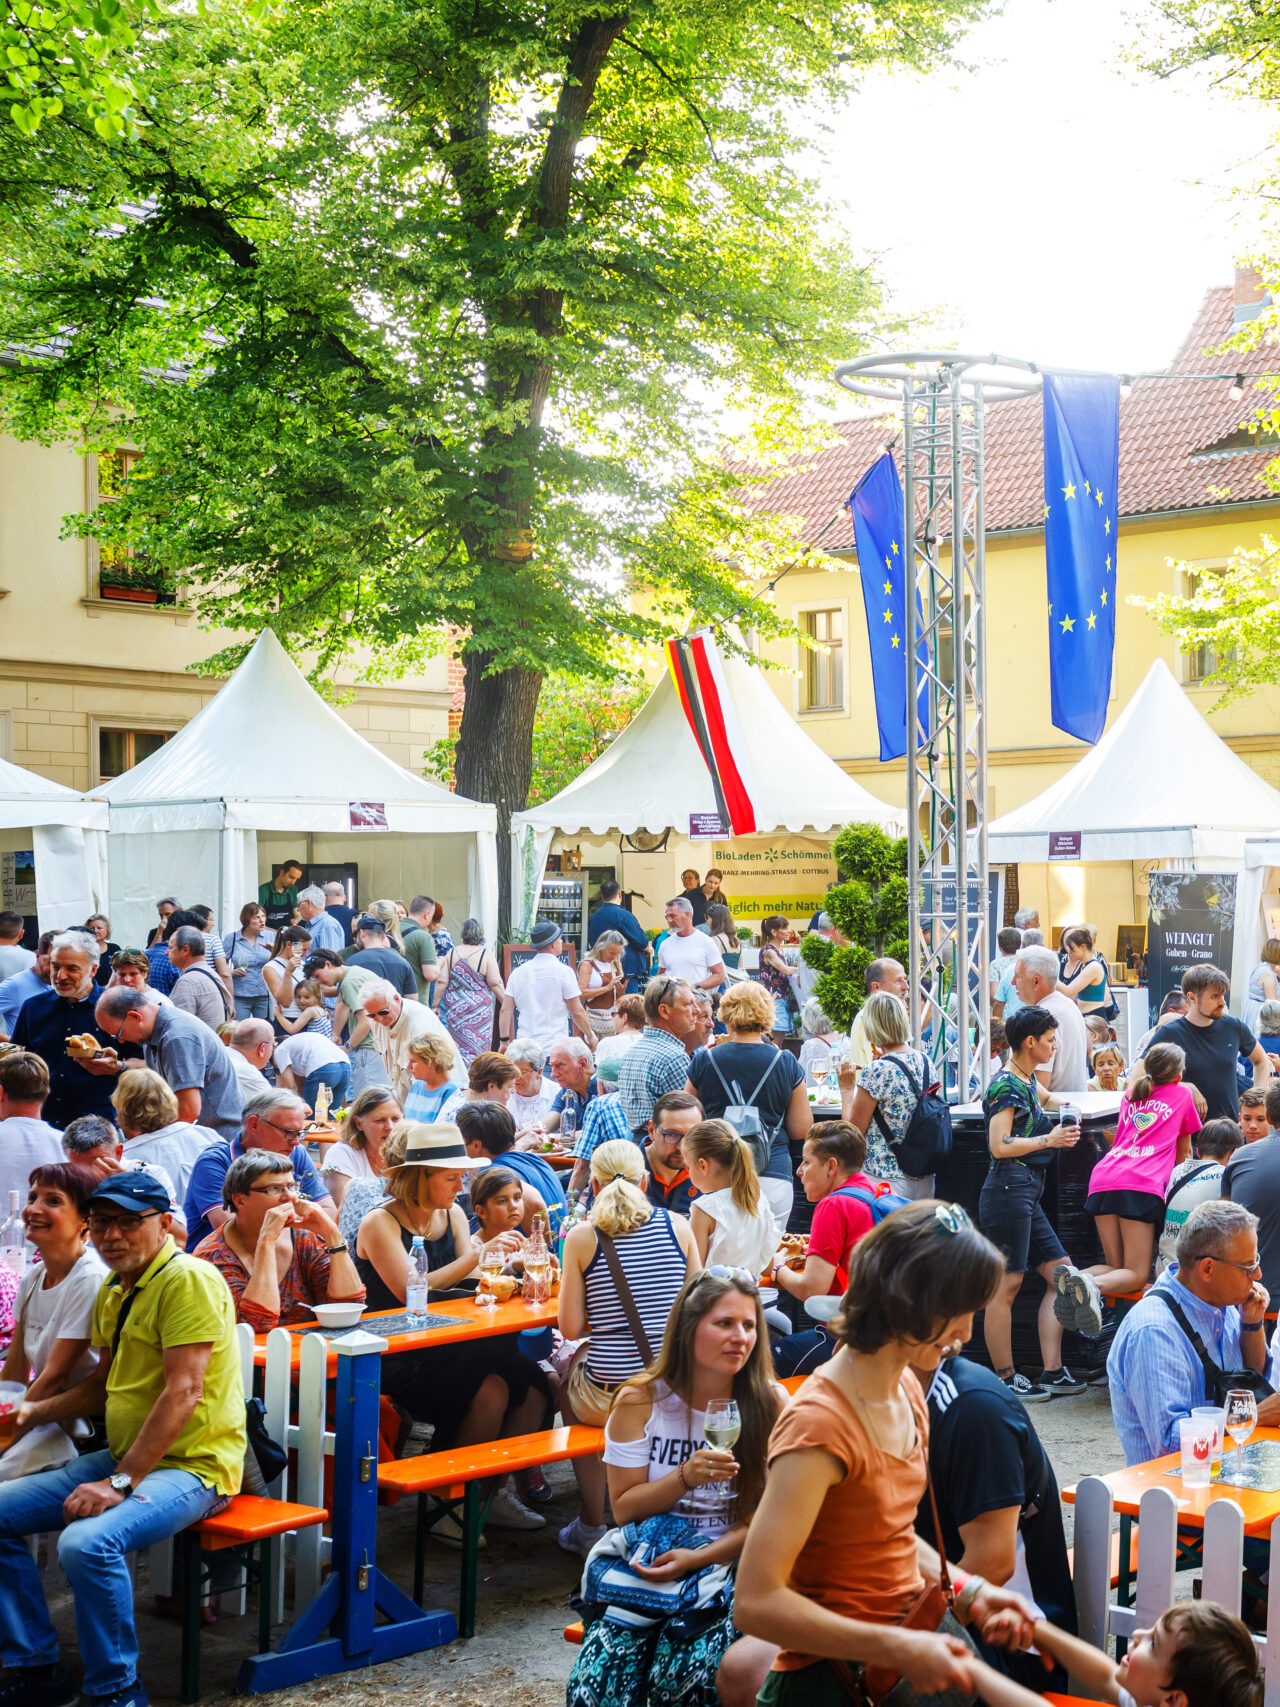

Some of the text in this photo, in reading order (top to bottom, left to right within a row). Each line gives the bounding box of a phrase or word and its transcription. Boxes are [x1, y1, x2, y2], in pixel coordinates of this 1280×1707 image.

[715, 850, 832, 861] BioLaden Schömmel
[728, 900, 824, 915] äglich mehr Natu
[1165, 931, 1214, 946] WEINGUT
[1165, 948, 1213, 959] Guben Grano
[1123, 1100, 1173, 1126] LOLLIPOPS
